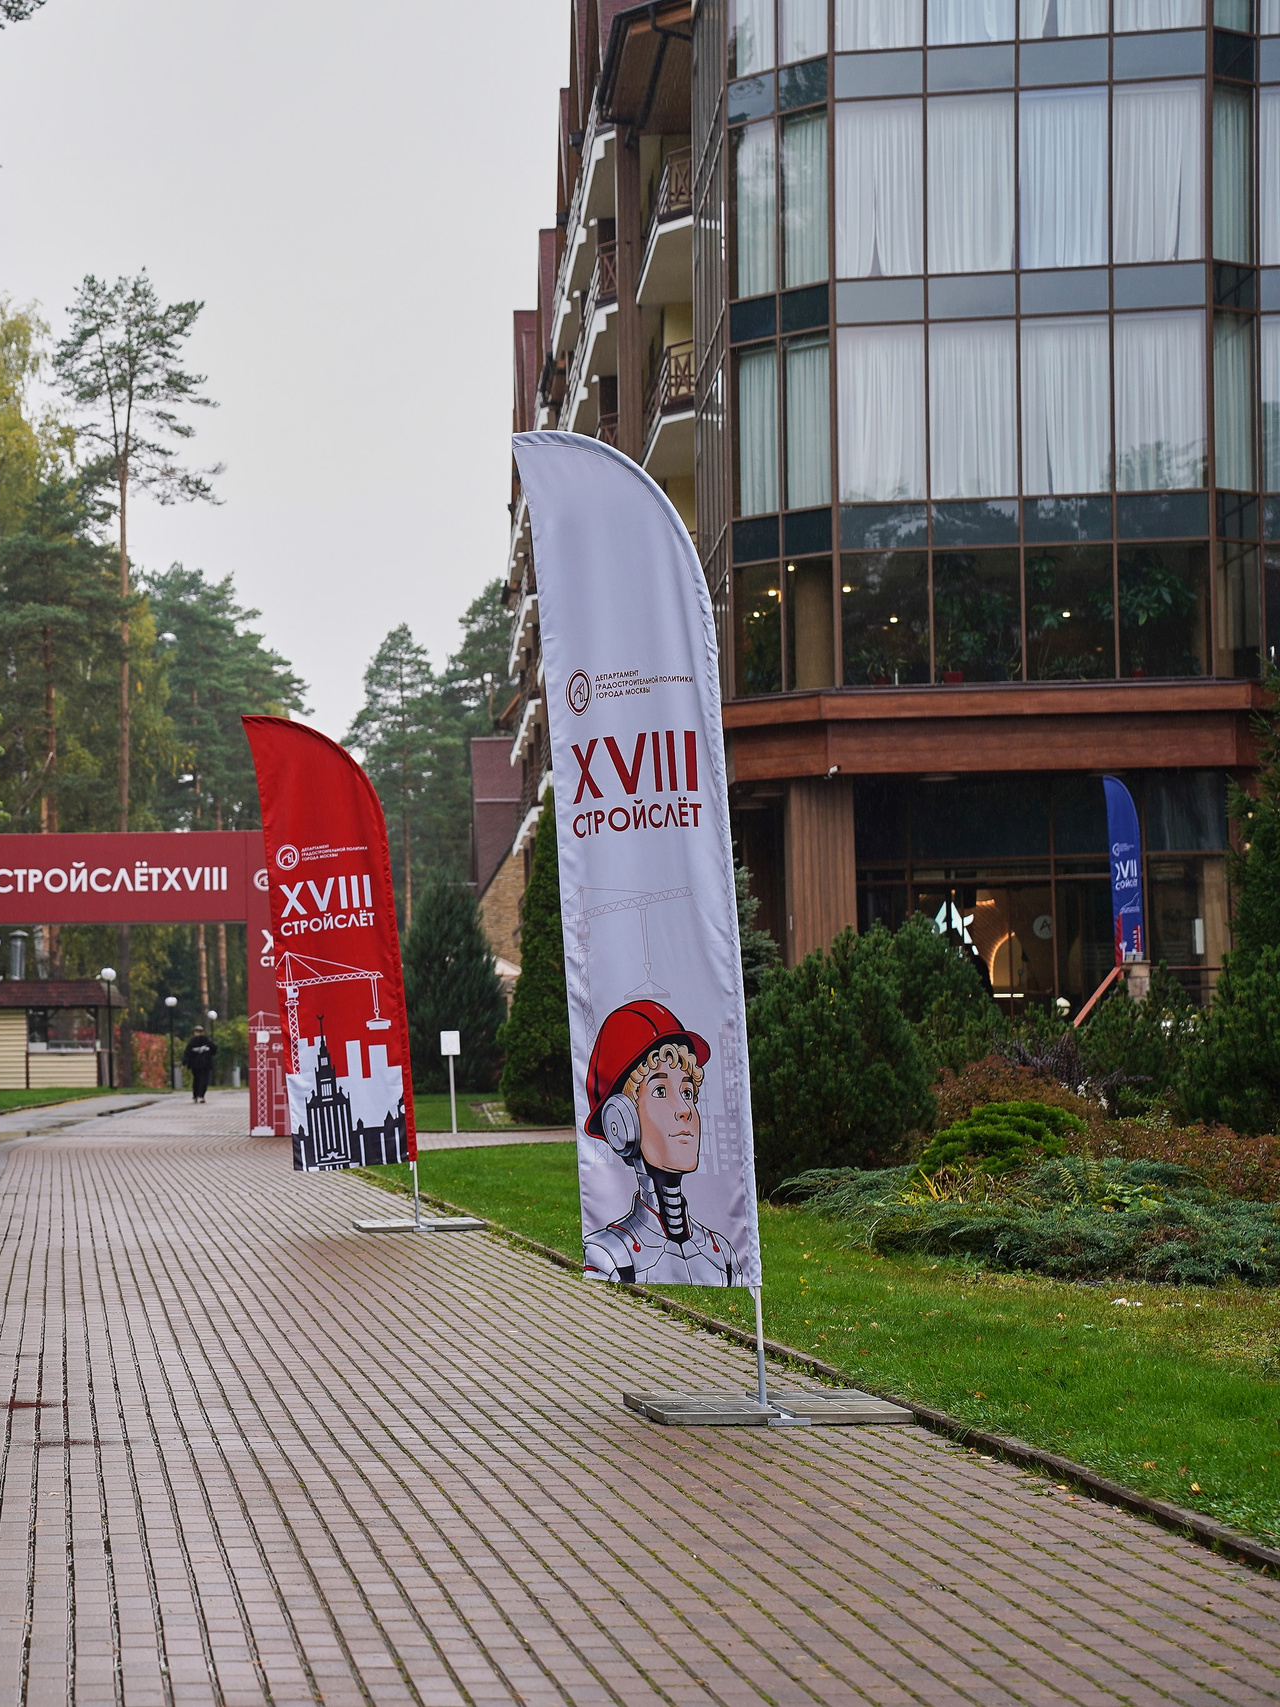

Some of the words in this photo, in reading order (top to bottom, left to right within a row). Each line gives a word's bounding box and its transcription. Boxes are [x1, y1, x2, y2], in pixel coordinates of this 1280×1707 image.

[595, 670, 639, 682] ДЕПАРТАМЕНТ
[595, 675, 659, 690] ГРАДОСТРОИТЕЛЬНОЙ
[659, 675, 694, 683] ПОЛИТИКИ
[595, 690, 624, 699] ГОРОДА
[625, 687, 650, 696] МОСКВЫ
[570, 730, 699, 805] XVIII
[572, 796, 702, 839] СТРОЙСЛЁТ
[279, 874, 373, 918] XVIII
[280, 909, 375, 937] СТРОЙСЛЁТ
